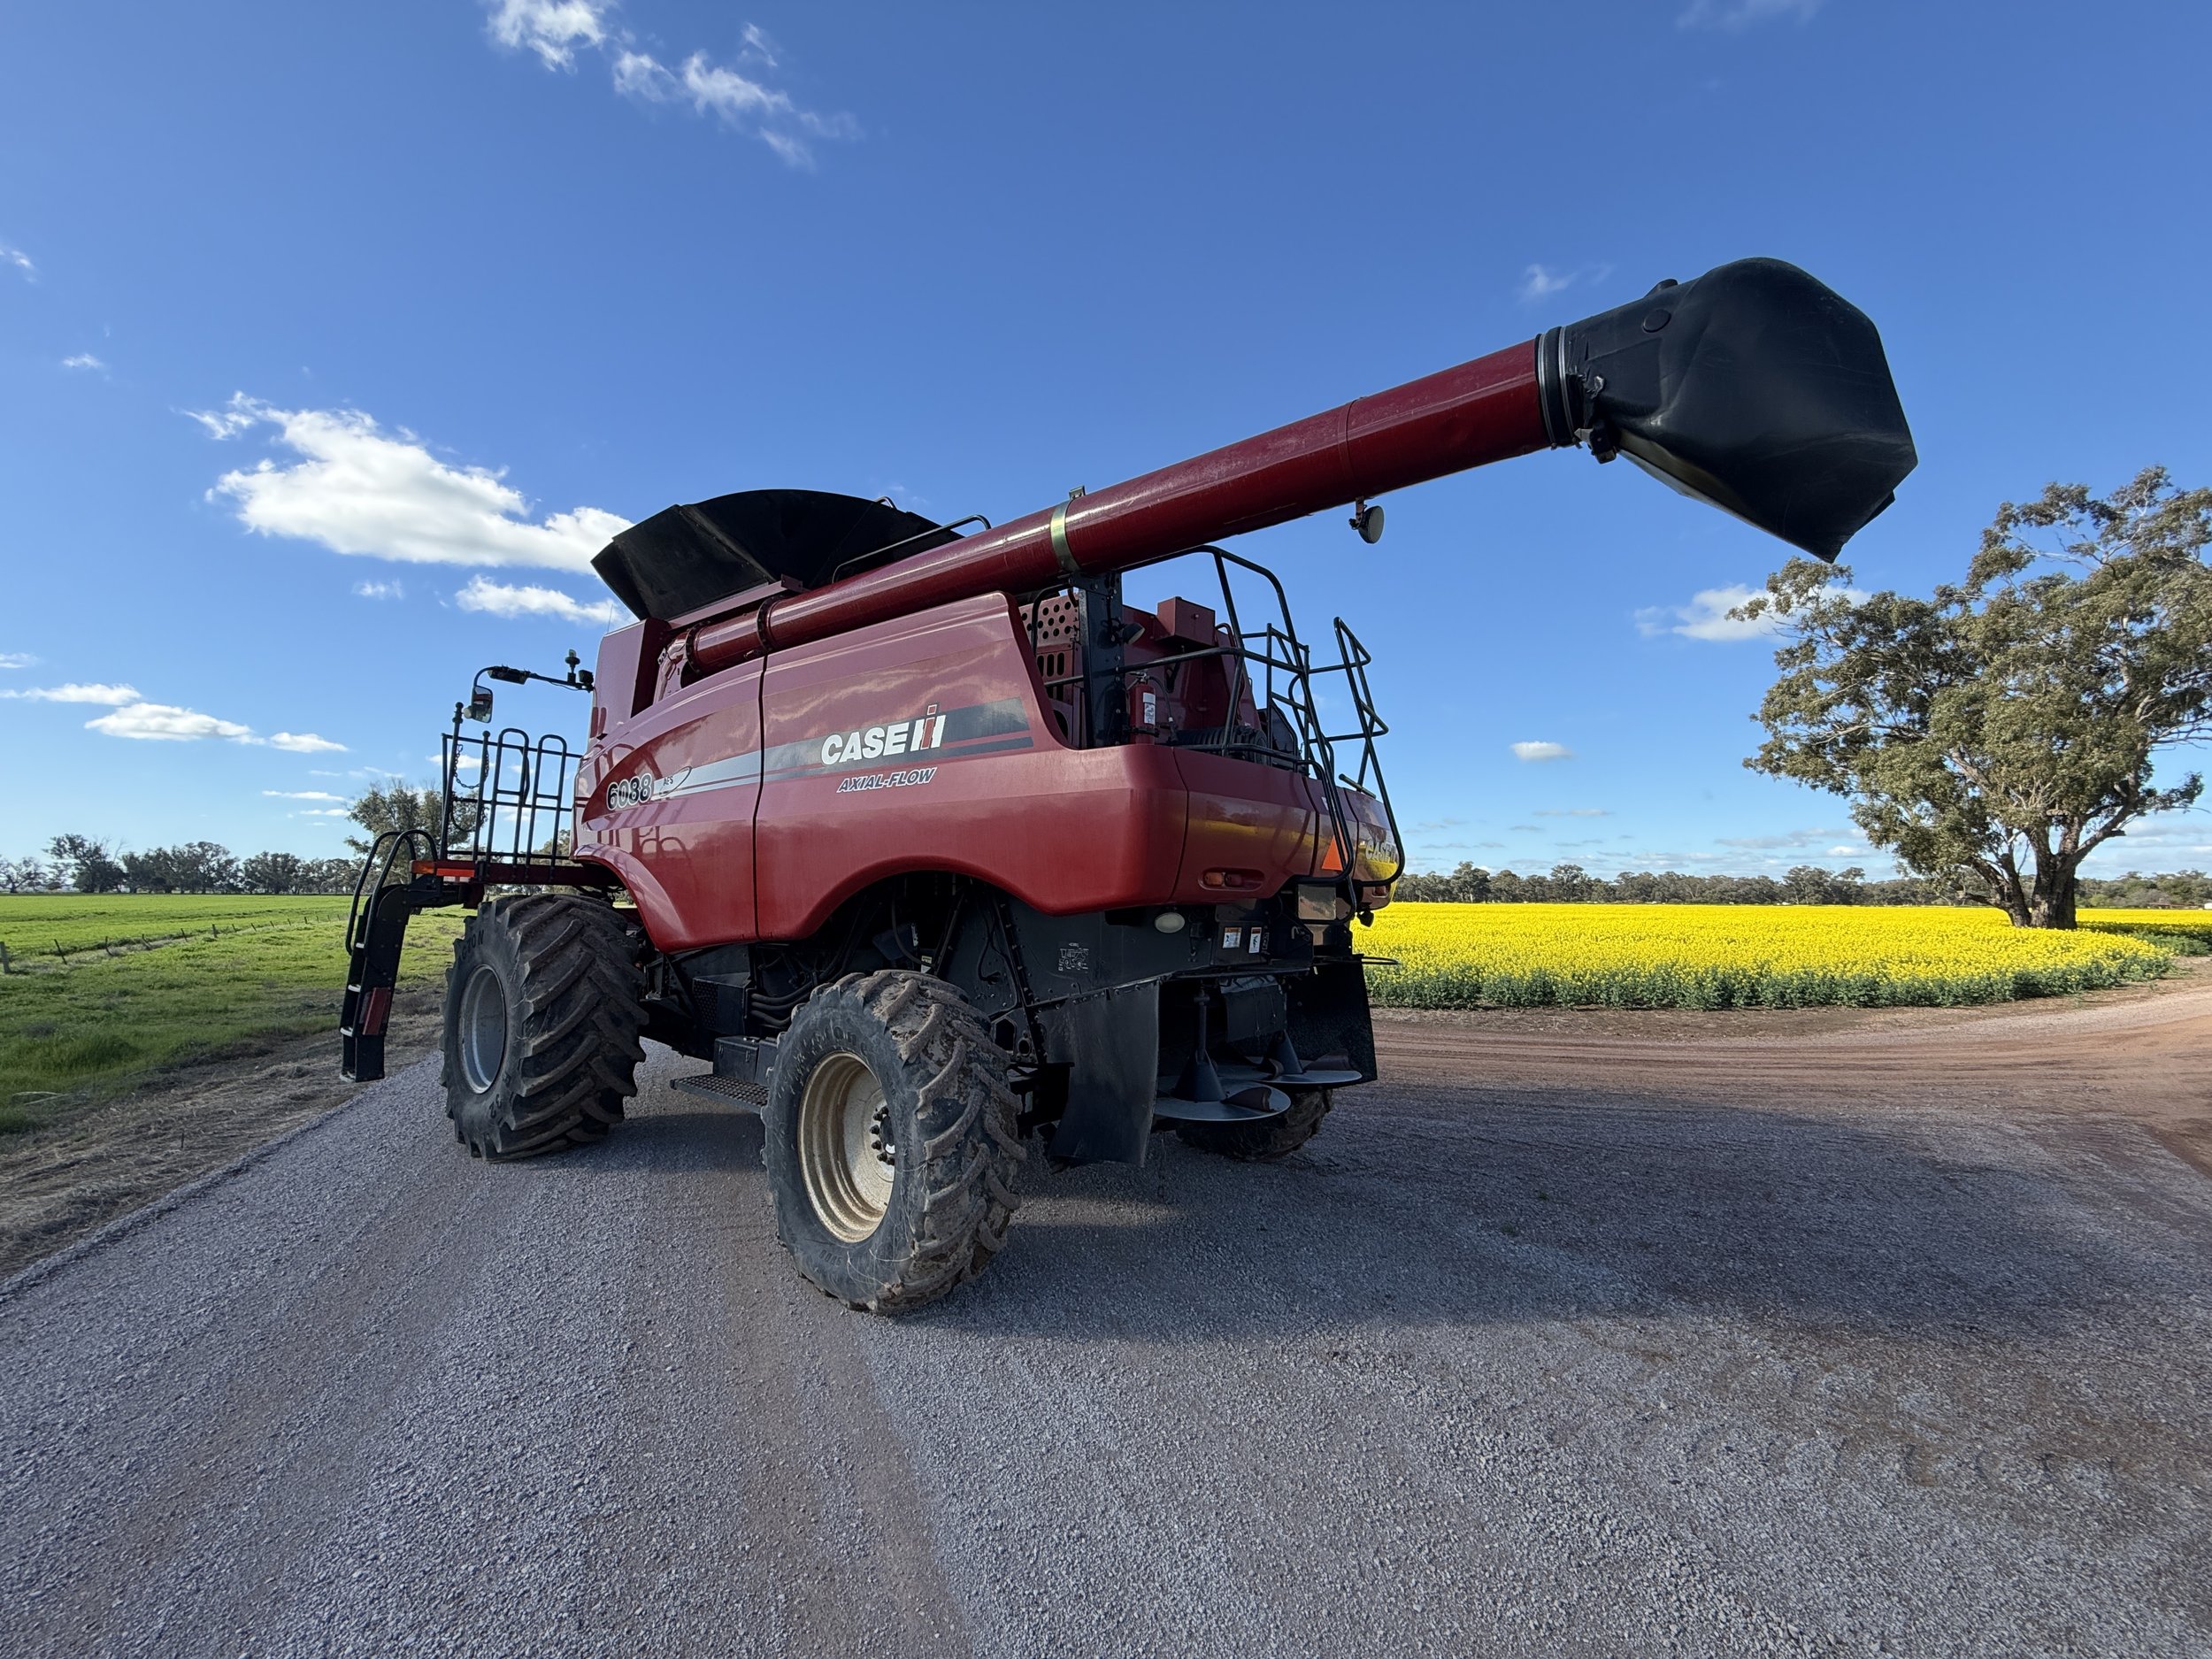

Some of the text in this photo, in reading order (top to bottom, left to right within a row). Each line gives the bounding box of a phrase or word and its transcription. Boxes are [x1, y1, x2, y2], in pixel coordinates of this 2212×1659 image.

[821, 722, 910, 765] CASE
[606, 772, 653, 811] 6088
[836, 766, 938, 794] AXIAL-FLOW
